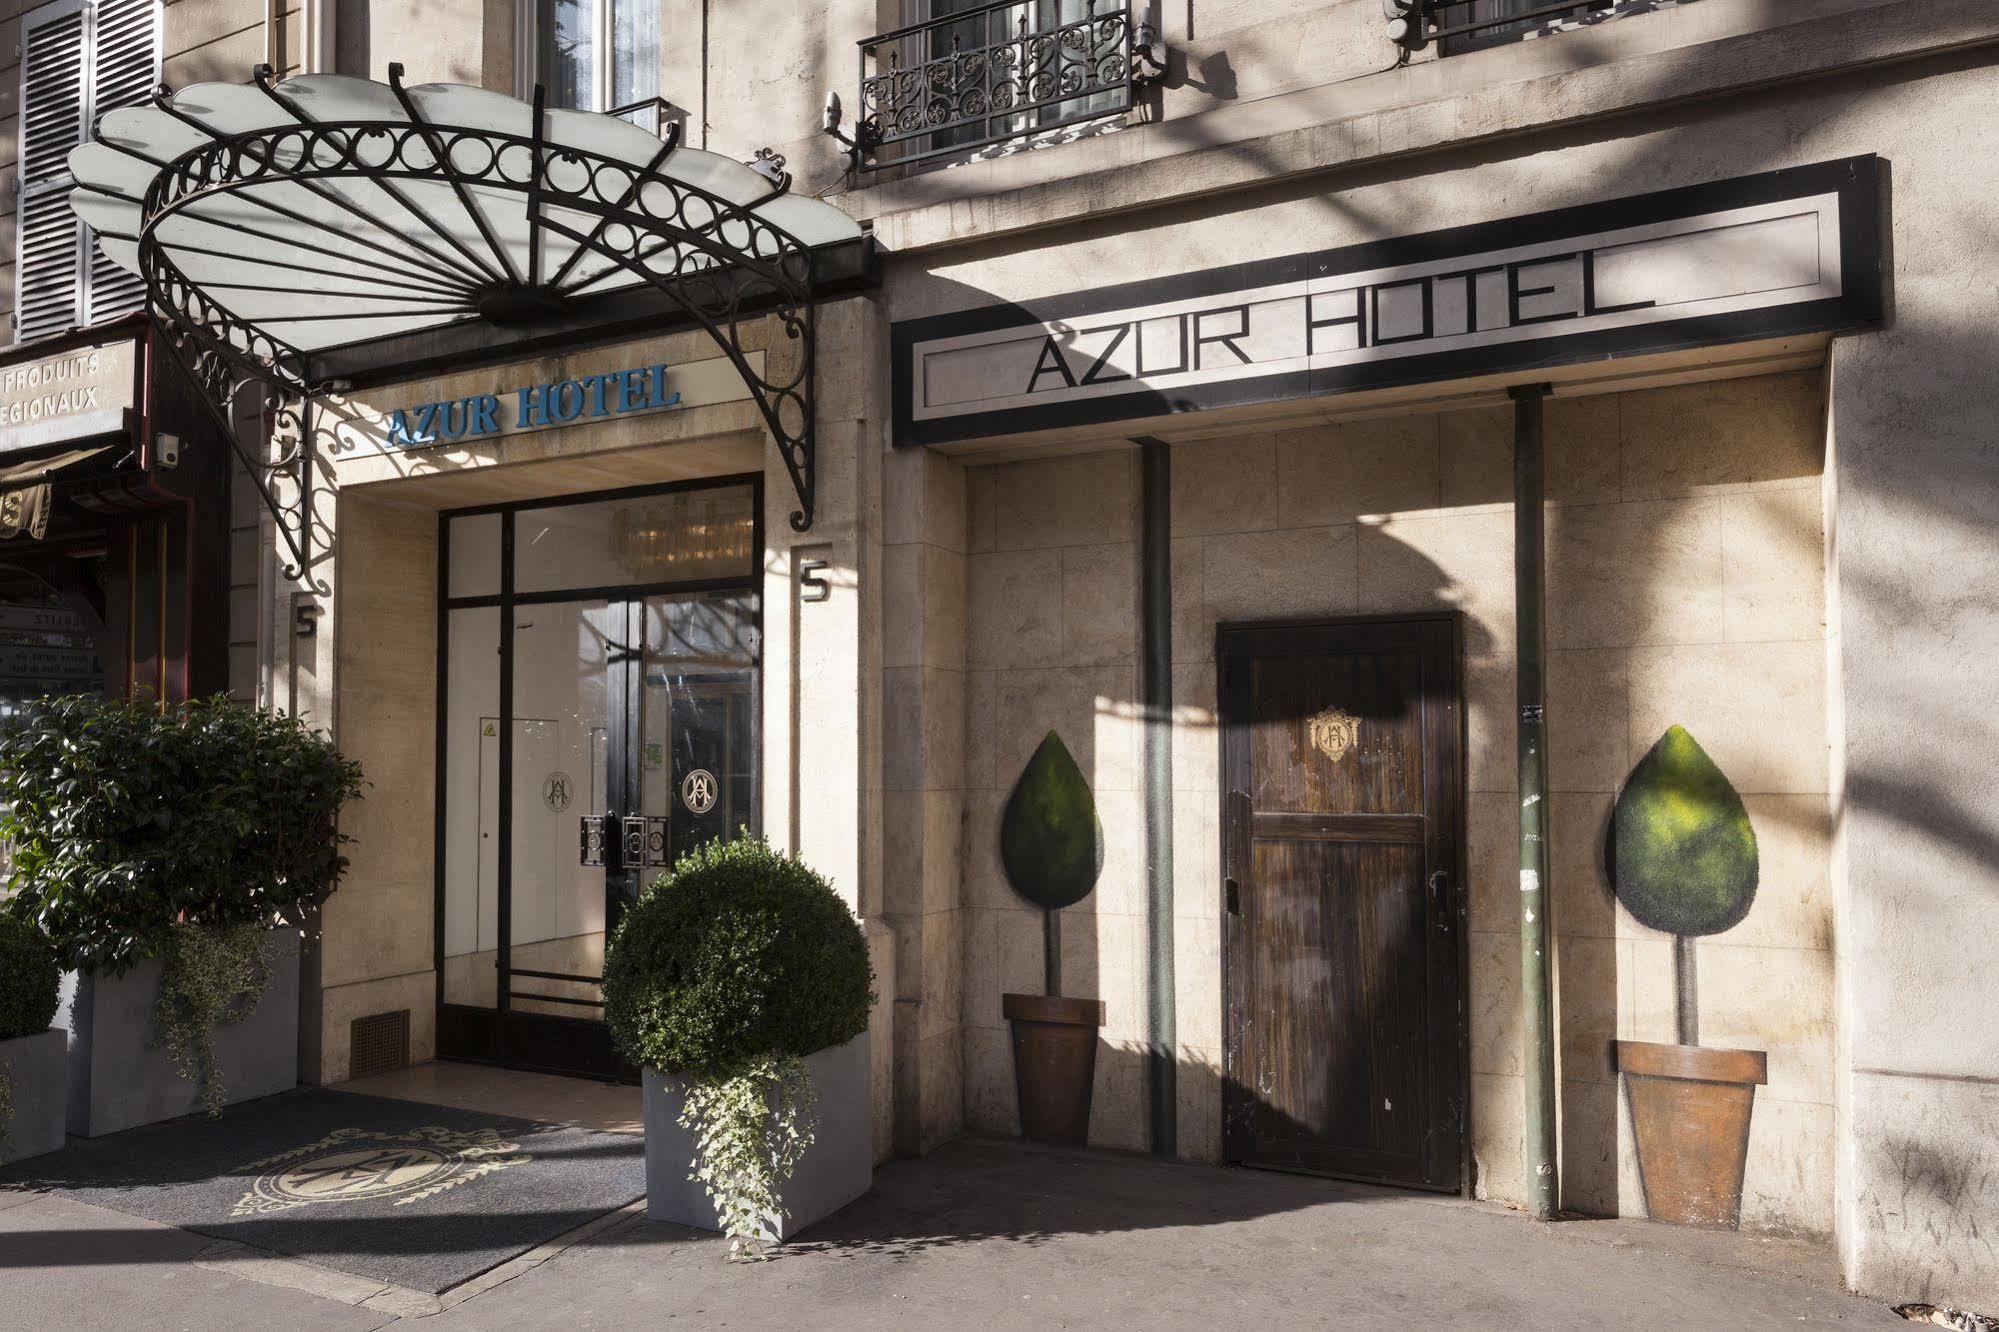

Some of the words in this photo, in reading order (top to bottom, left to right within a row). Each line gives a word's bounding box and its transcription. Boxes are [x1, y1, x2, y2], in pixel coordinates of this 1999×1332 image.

[1027, 304, 1253, 394] AZUR
[1305, 248, 1656, 357] HOTEL
[4, 353, 99, 395] PRODUITS
[383, 394, 500, 449] AZUR
[515, 363, 682, 430] HOTEL
[800, 560, 828, 603] 5
[296, 605, 318, 638] 5
